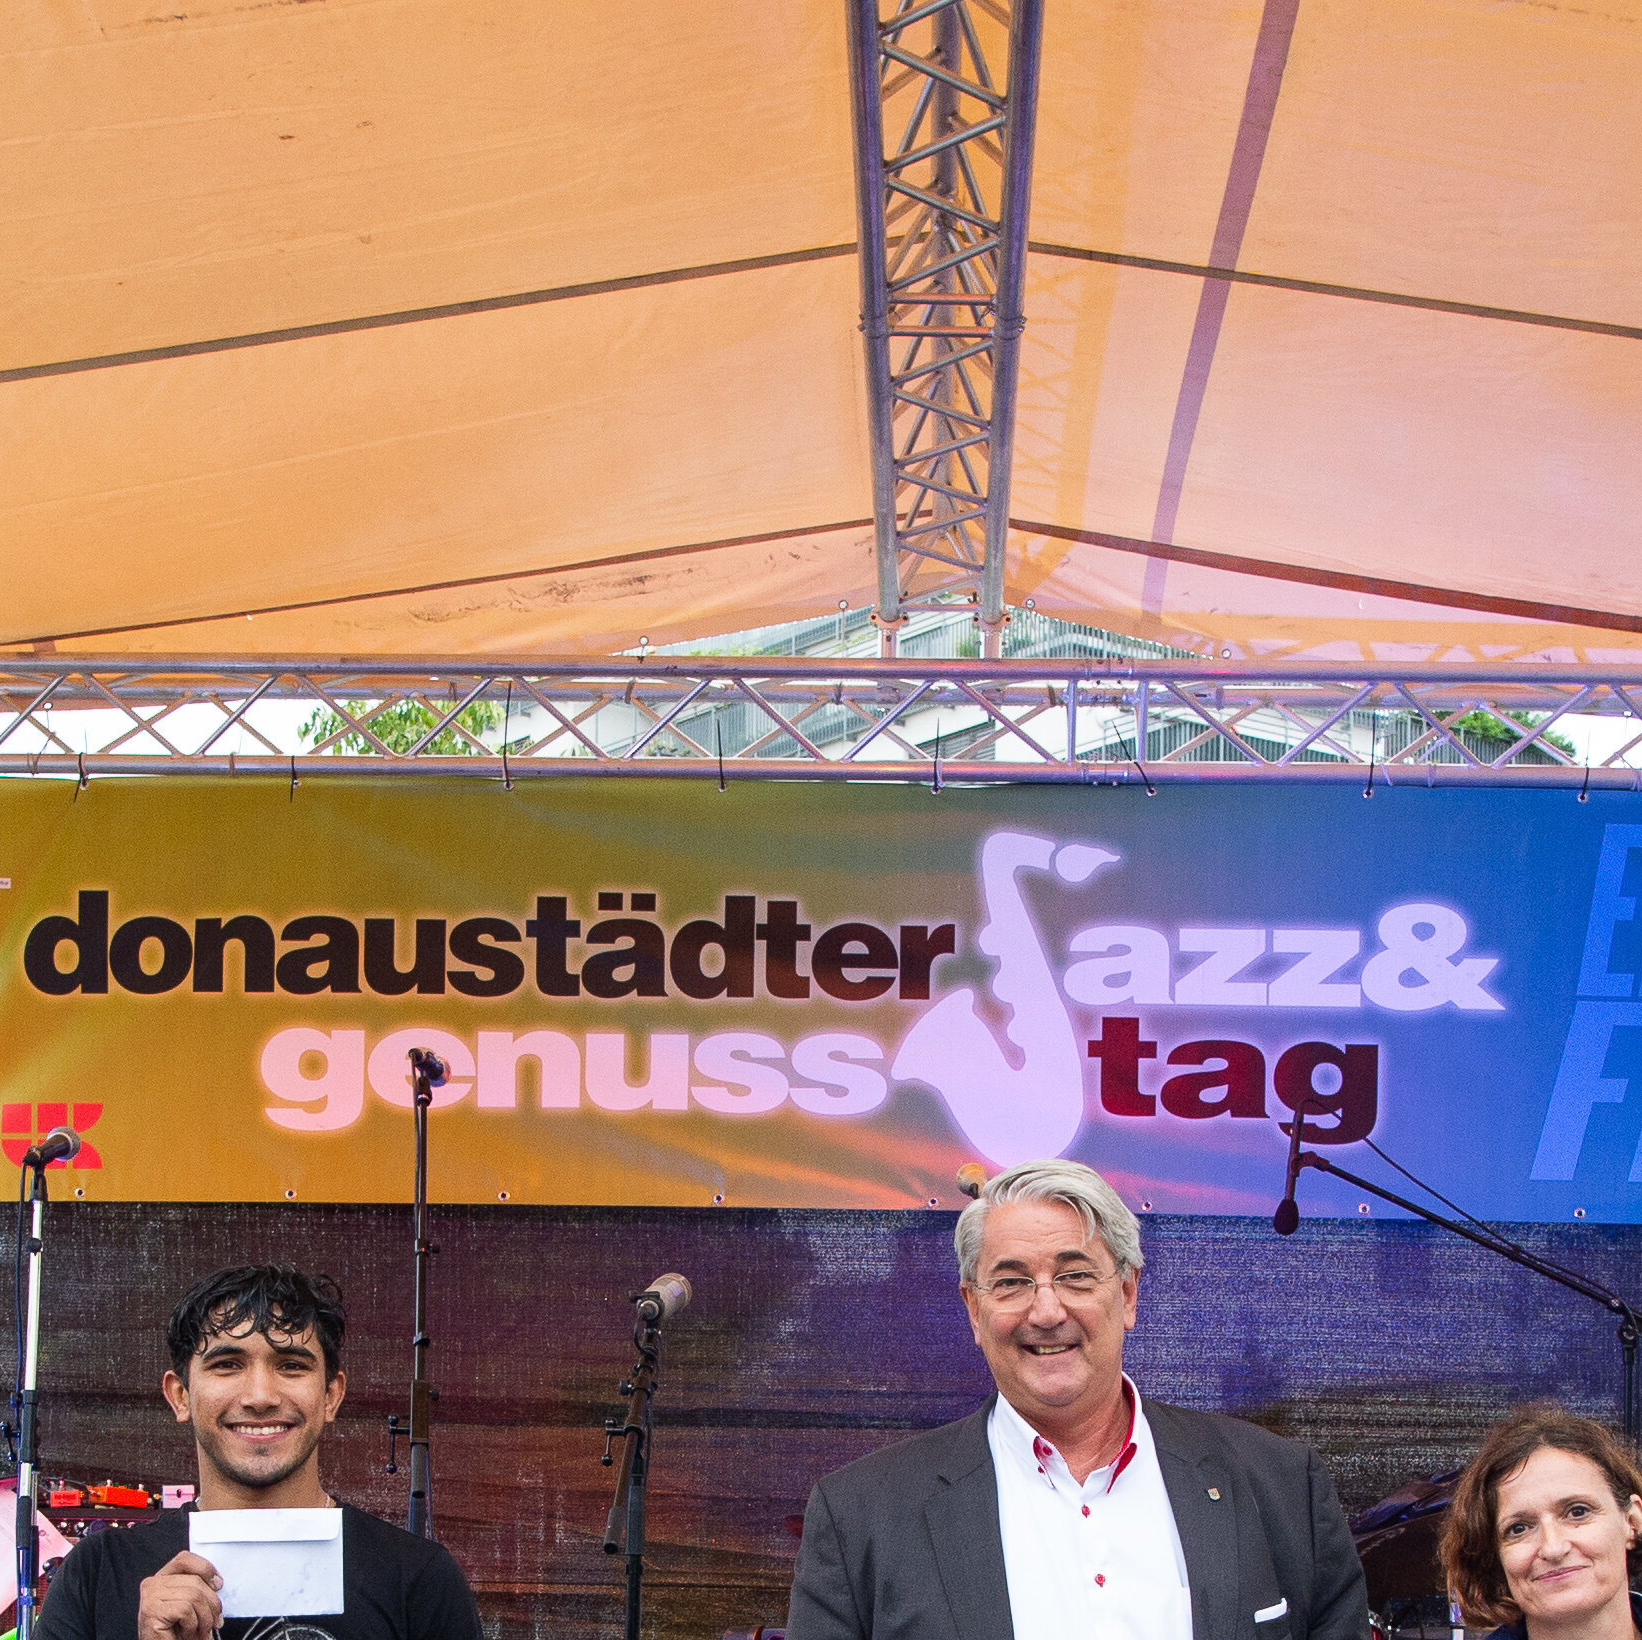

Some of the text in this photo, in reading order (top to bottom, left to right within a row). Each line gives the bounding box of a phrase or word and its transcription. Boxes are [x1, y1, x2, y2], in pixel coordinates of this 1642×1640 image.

[23, 889, 957, 1001] donaustädter
[261, 1015, 1379, 1146] genuss tag
